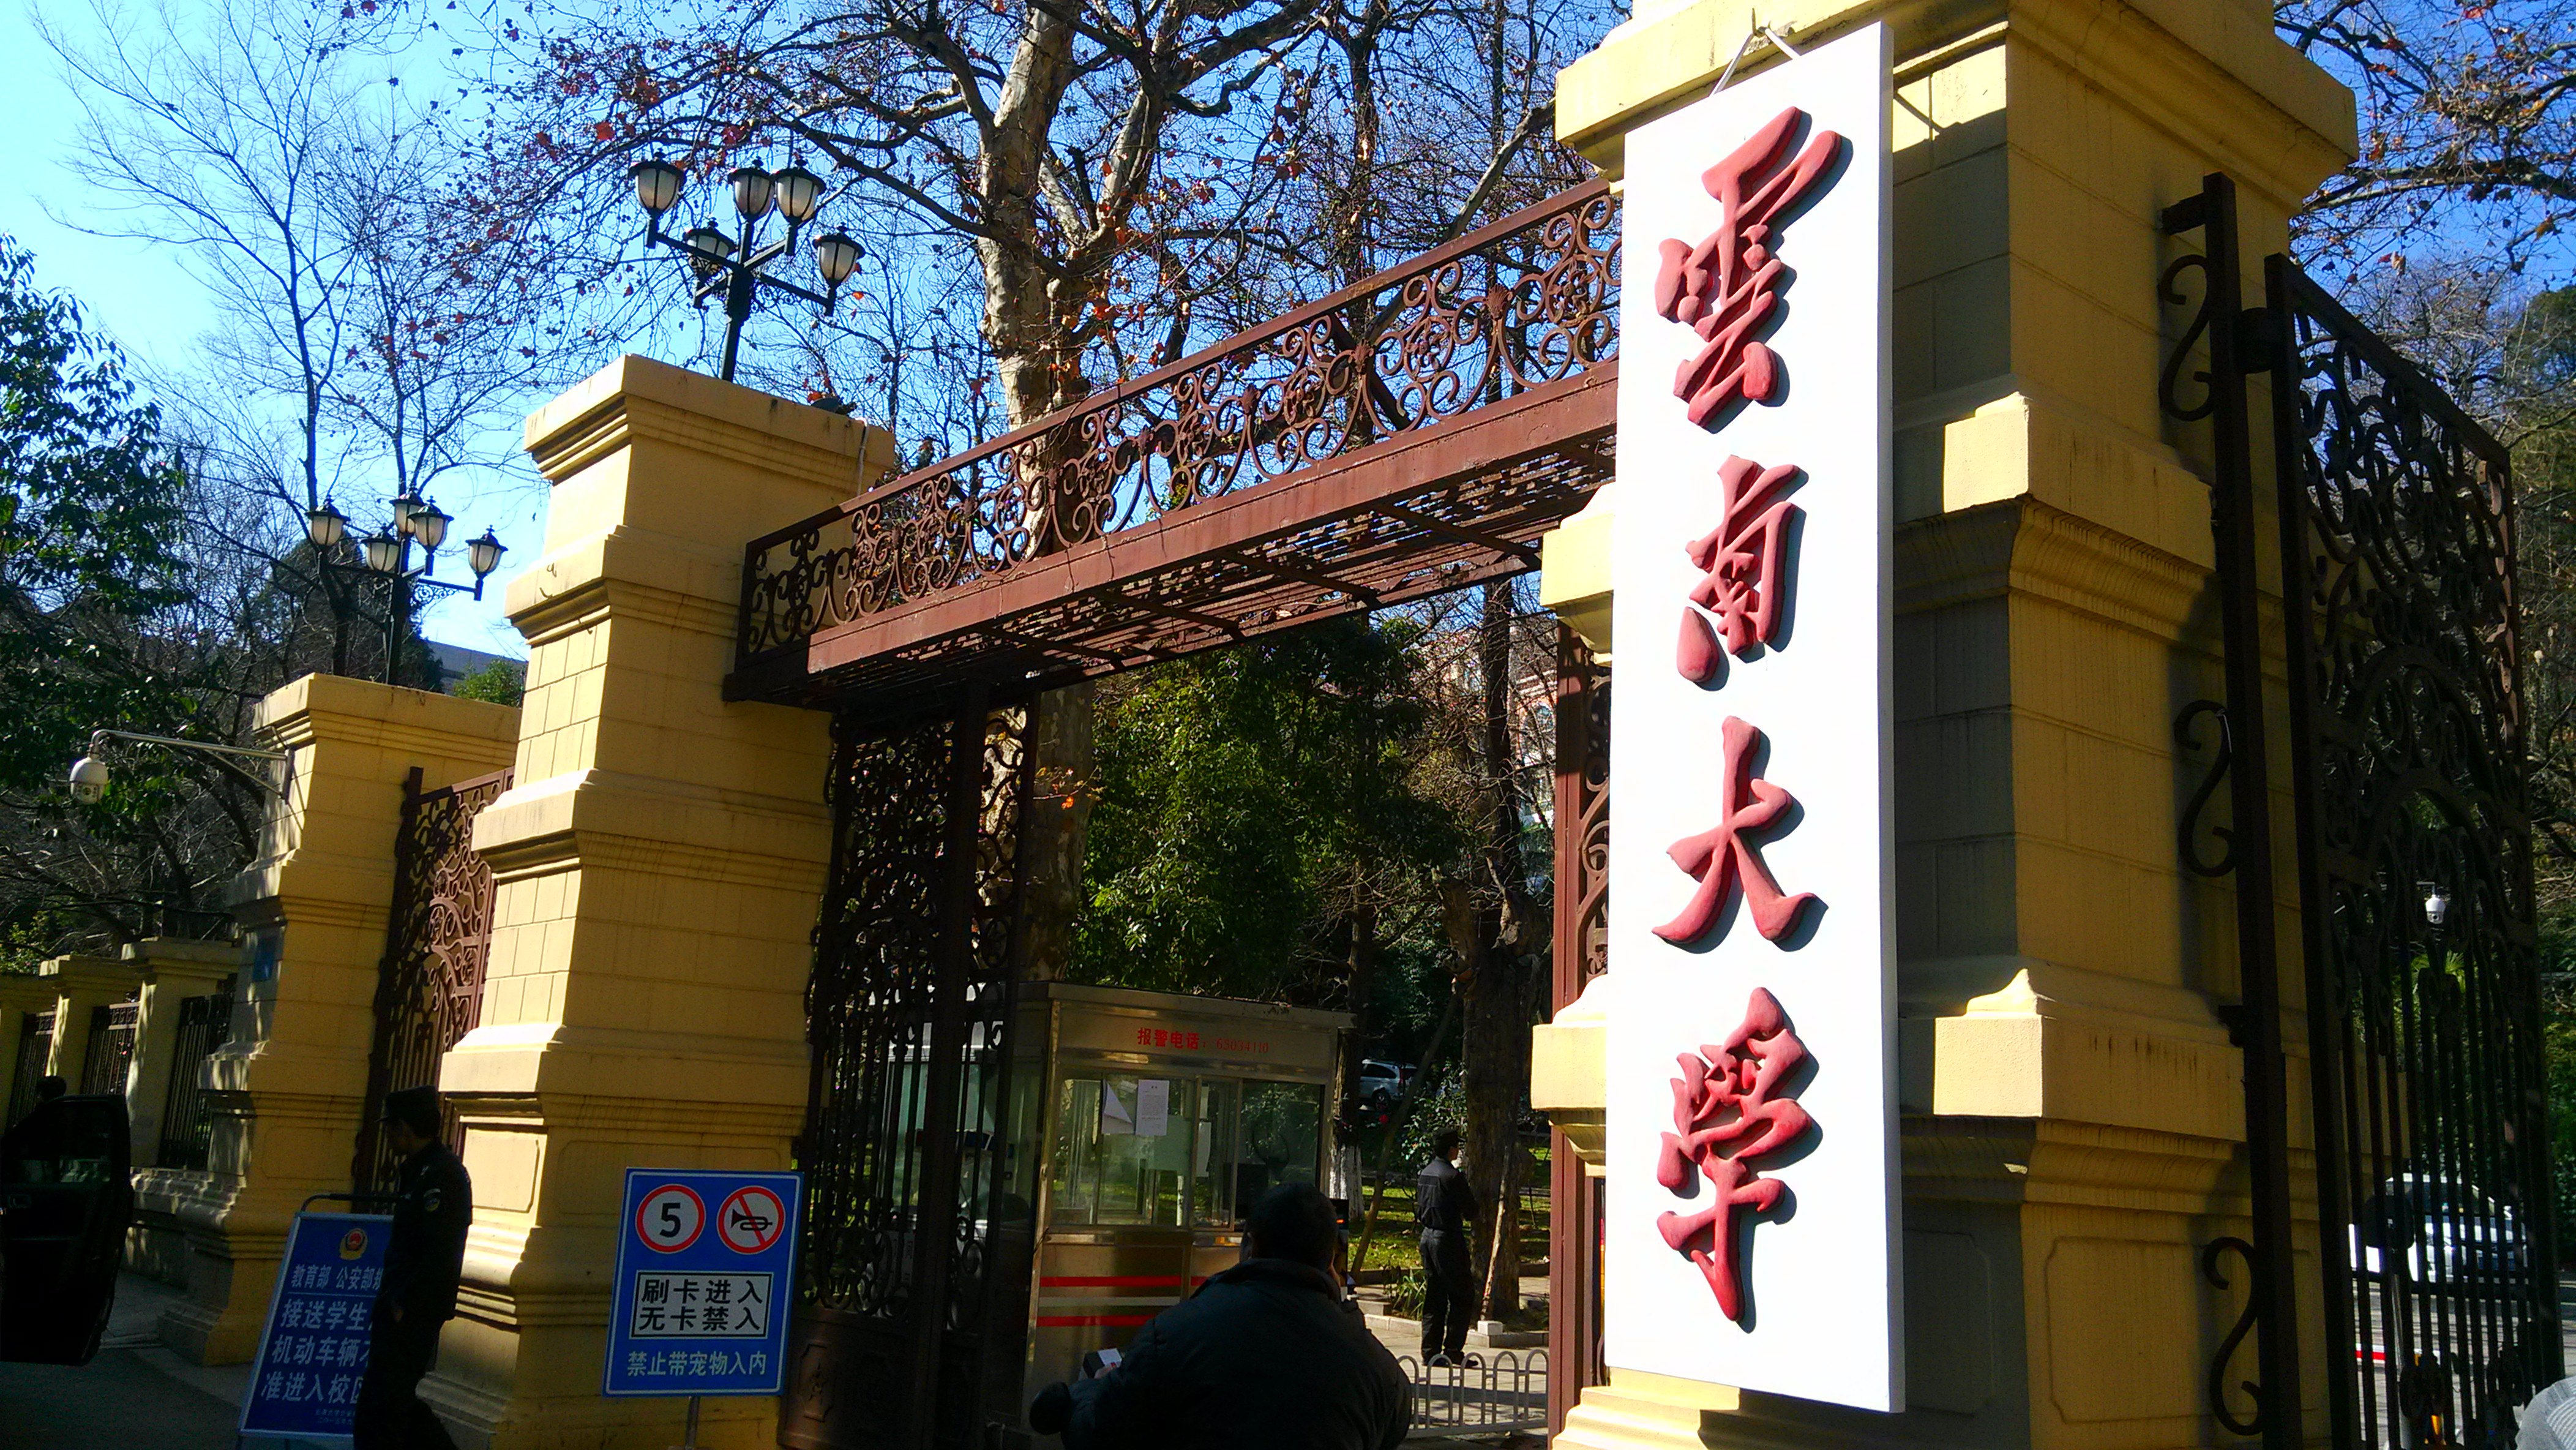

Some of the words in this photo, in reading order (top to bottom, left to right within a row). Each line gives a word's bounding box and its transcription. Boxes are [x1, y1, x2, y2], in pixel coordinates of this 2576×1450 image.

[659, 1202, 681, 1238] 5
[291, 1263, 332, 1290] 教育部
[641, 1279, 763, 1305] 刷卡进入
[638, 1305, 761, 1332] 无卡禁入
[627, 1350, 766, 1377] 禁止带宠物入内
